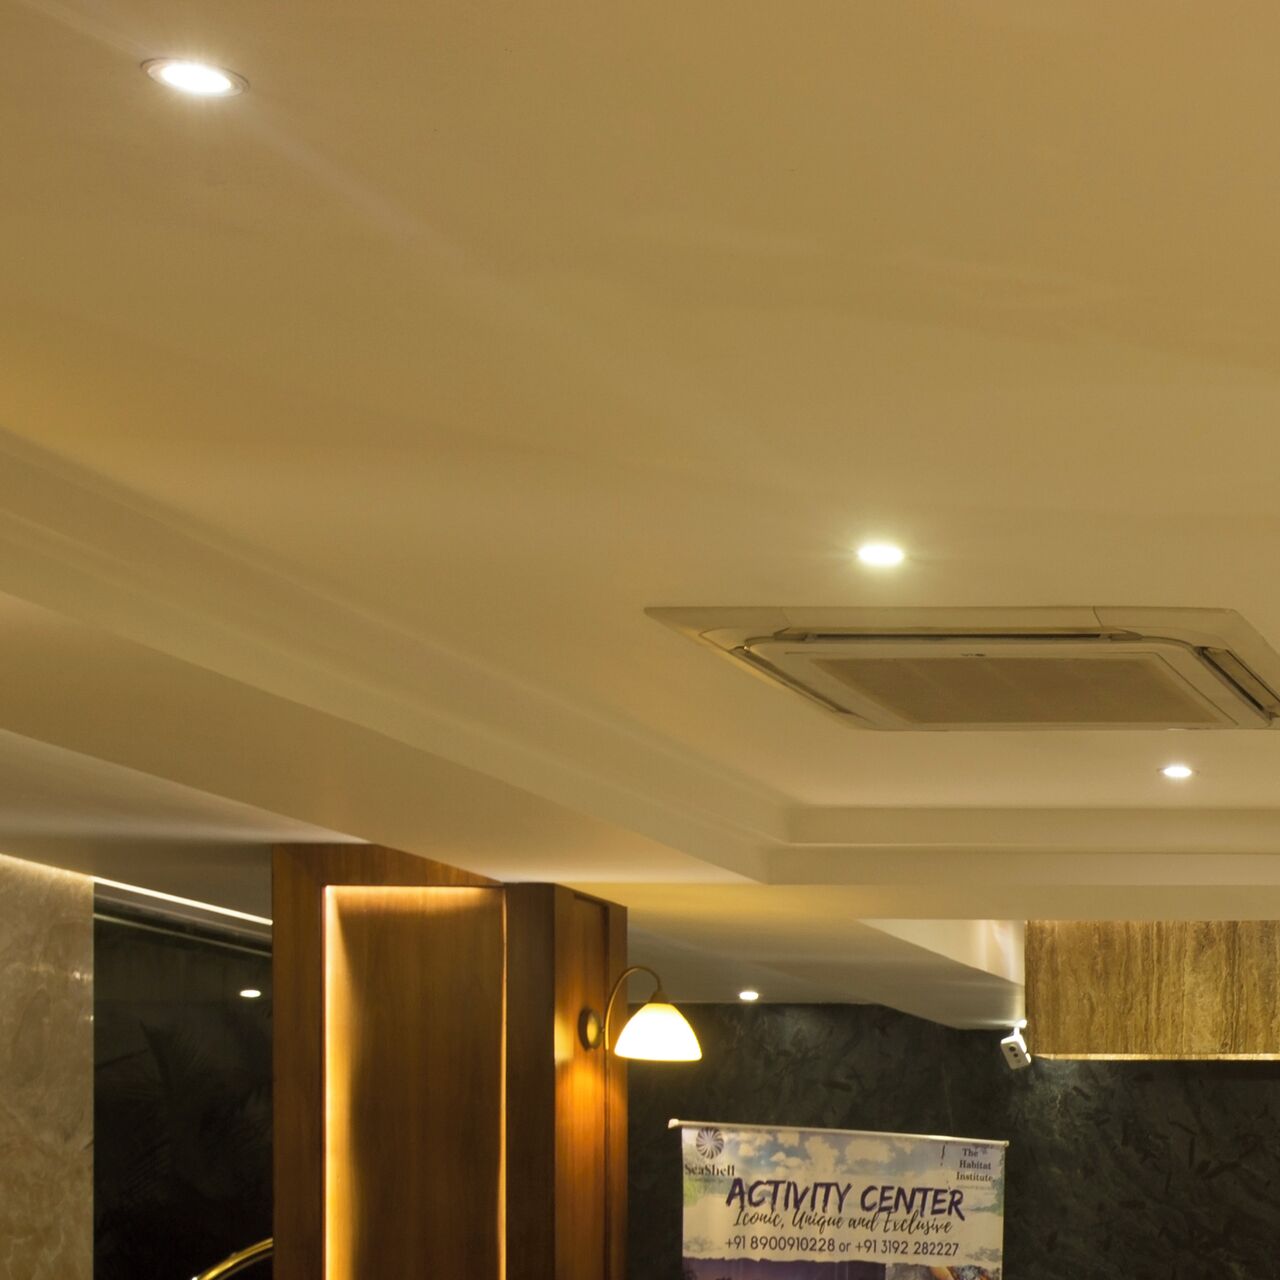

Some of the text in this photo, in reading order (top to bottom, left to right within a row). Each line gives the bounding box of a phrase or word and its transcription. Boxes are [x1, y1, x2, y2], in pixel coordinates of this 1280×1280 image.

[962, 1147, 979, 1157] The
[684, 1163, 735, 1177] SeaShell
[959, 1159, 992, 1170] Habitat
[726, 1177, 965, 1221] ACTIVITY CENTER
[733, 1207, 953, 1236] Iconic, Unique and Exclusive
[725, 1235, 960, 1257] +91 8900910228 or +91 3192 282227
